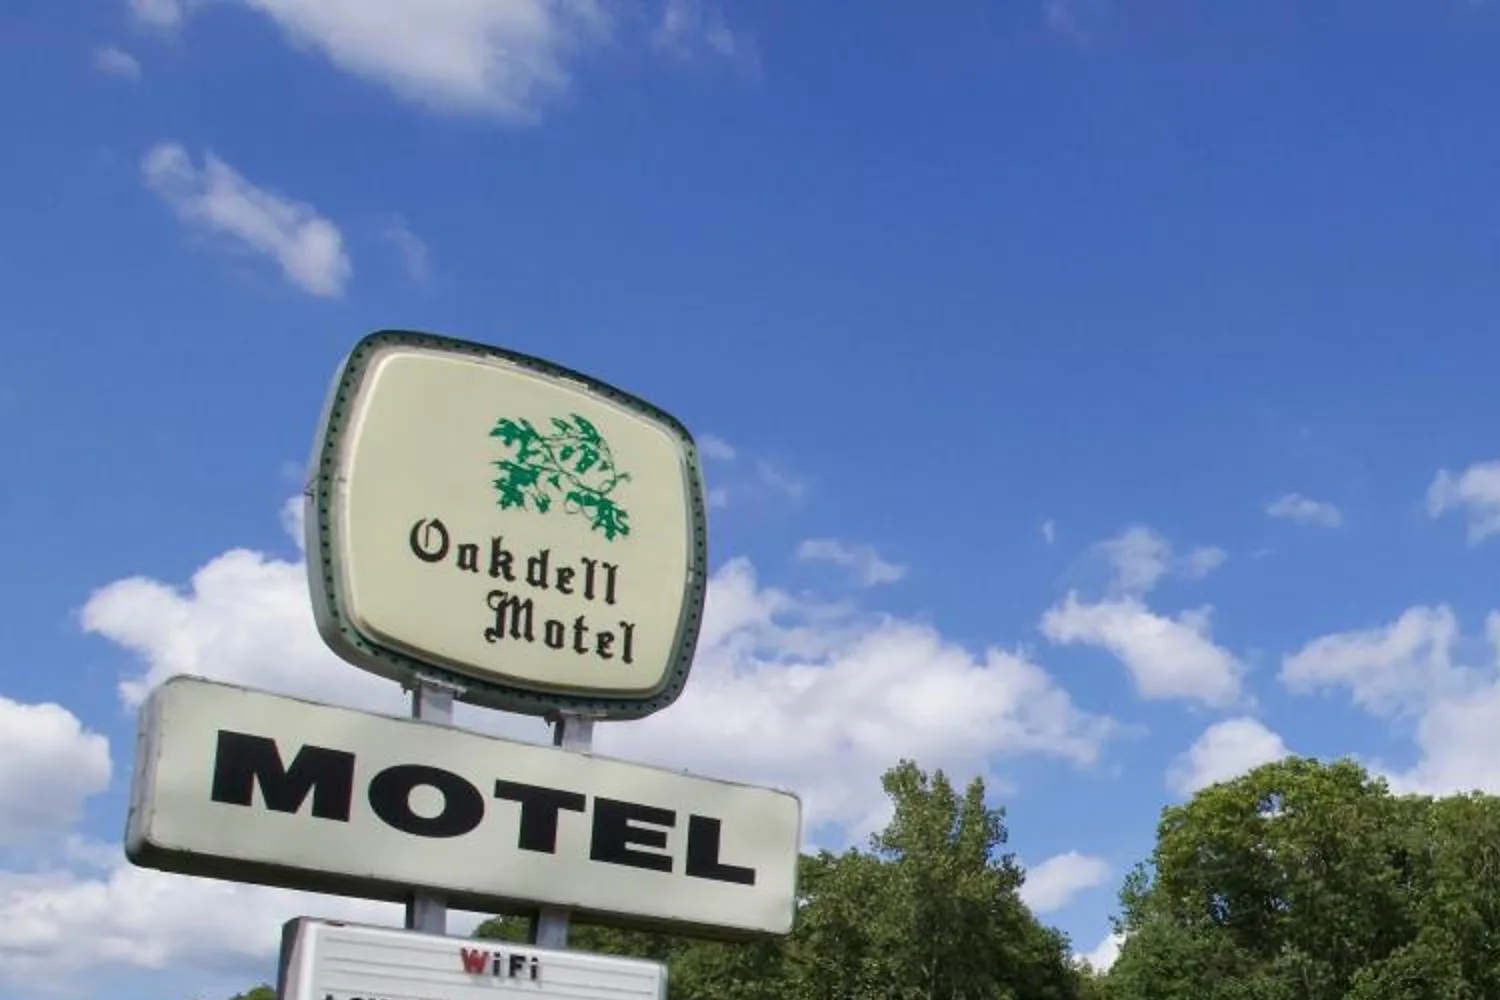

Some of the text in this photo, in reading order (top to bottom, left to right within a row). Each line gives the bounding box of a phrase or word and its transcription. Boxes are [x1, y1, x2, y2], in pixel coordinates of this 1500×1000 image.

[409, 517, 619, 605] Oakdell
[484, 590, 636, 664] Motel
[211, 728, 756, 886] MOTEL
[460, 947, 541, 982] WiFi
